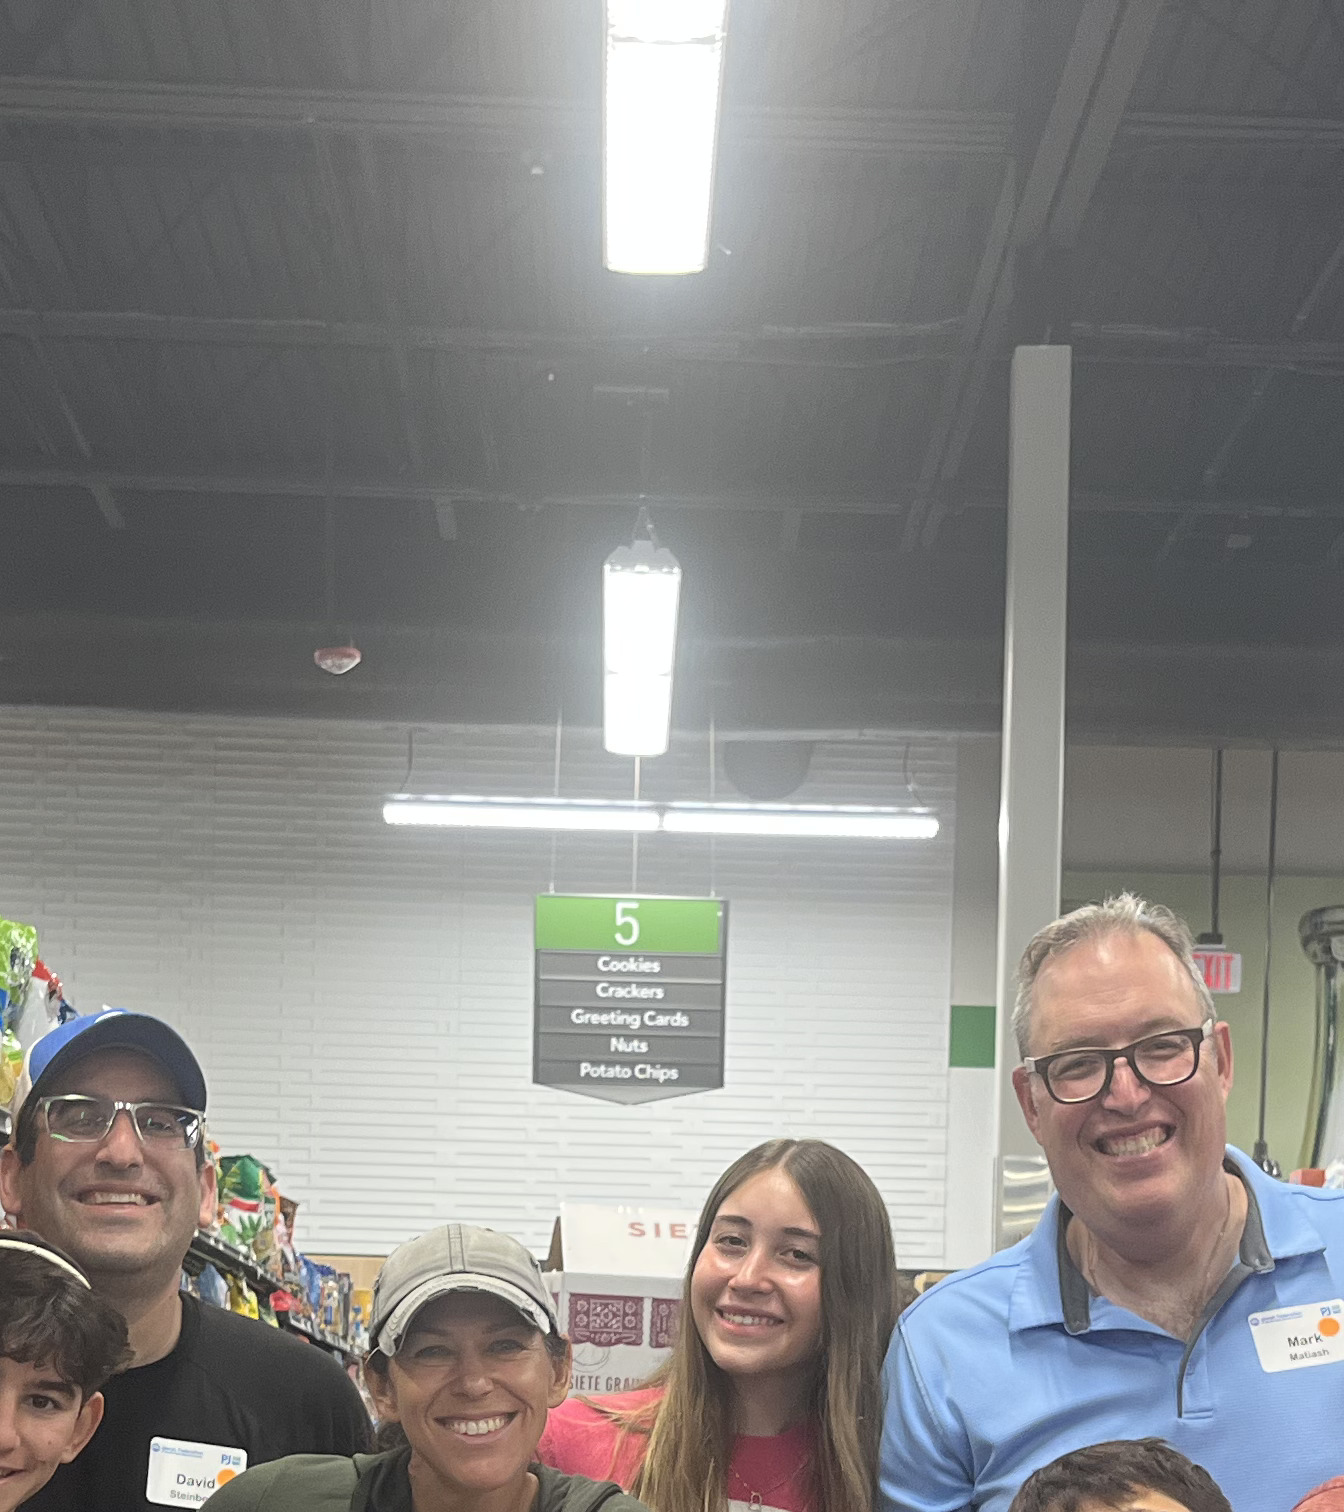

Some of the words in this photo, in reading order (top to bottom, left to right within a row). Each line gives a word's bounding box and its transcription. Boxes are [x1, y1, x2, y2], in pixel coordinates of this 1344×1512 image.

[615, 901, 640, 946] 5
[597, 956, 661, 973] Cookies
[596, 983, 664, 1000] Crackers
[571, 1009, 642, 1029] Greeting
[643, 1011, 690, 1027] Cards
[610, 1037, 649, 1053] Nuts
[579, 1062, 632, 1079] Potato
[634, 1064, 679, 1083] Chips
[628, 1221, 688, 1239] SIE
[1287, 1333, 1323, 1347] Mark
[177, 1474, 215, 1489] David
